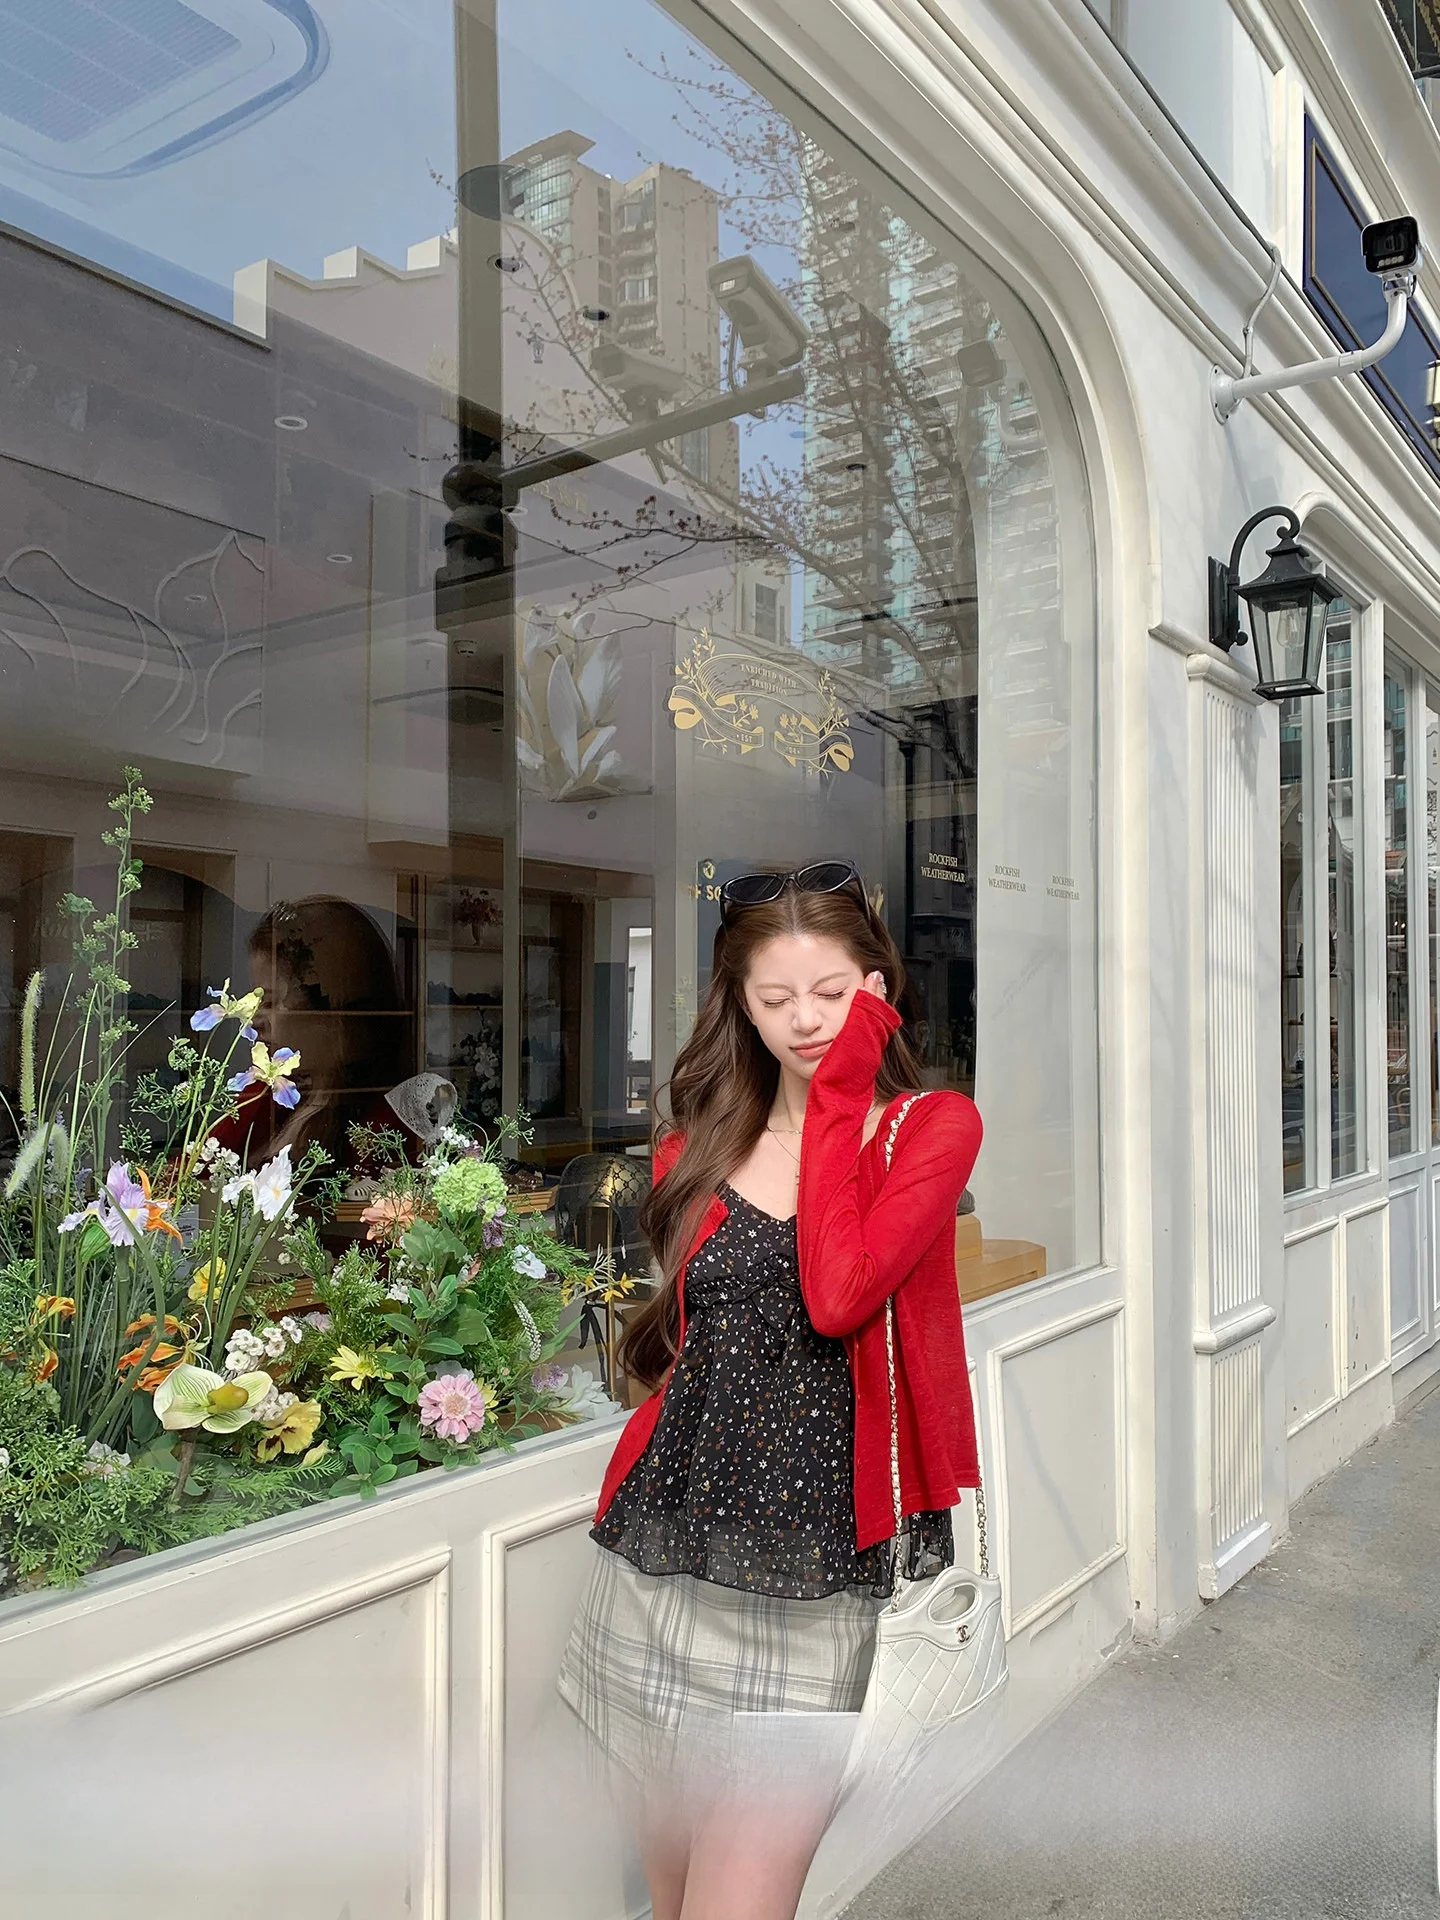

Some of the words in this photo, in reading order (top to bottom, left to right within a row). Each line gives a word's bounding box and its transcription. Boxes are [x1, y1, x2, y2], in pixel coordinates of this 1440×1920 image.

[750, 678, 787, 696] TRADITION
[928, 853, 957, 867] ROCKFISH
[921, 867, 965, 883] WEATHERWEAR
[994, 865, 1020, 878] ROCKFISH
[988, 878, 1026, 892] WEATHERWEAR
[1052, 875, 1074, 887] ROCKFISH
[1046, 887, 1080, 901] WEATHERWEAR
